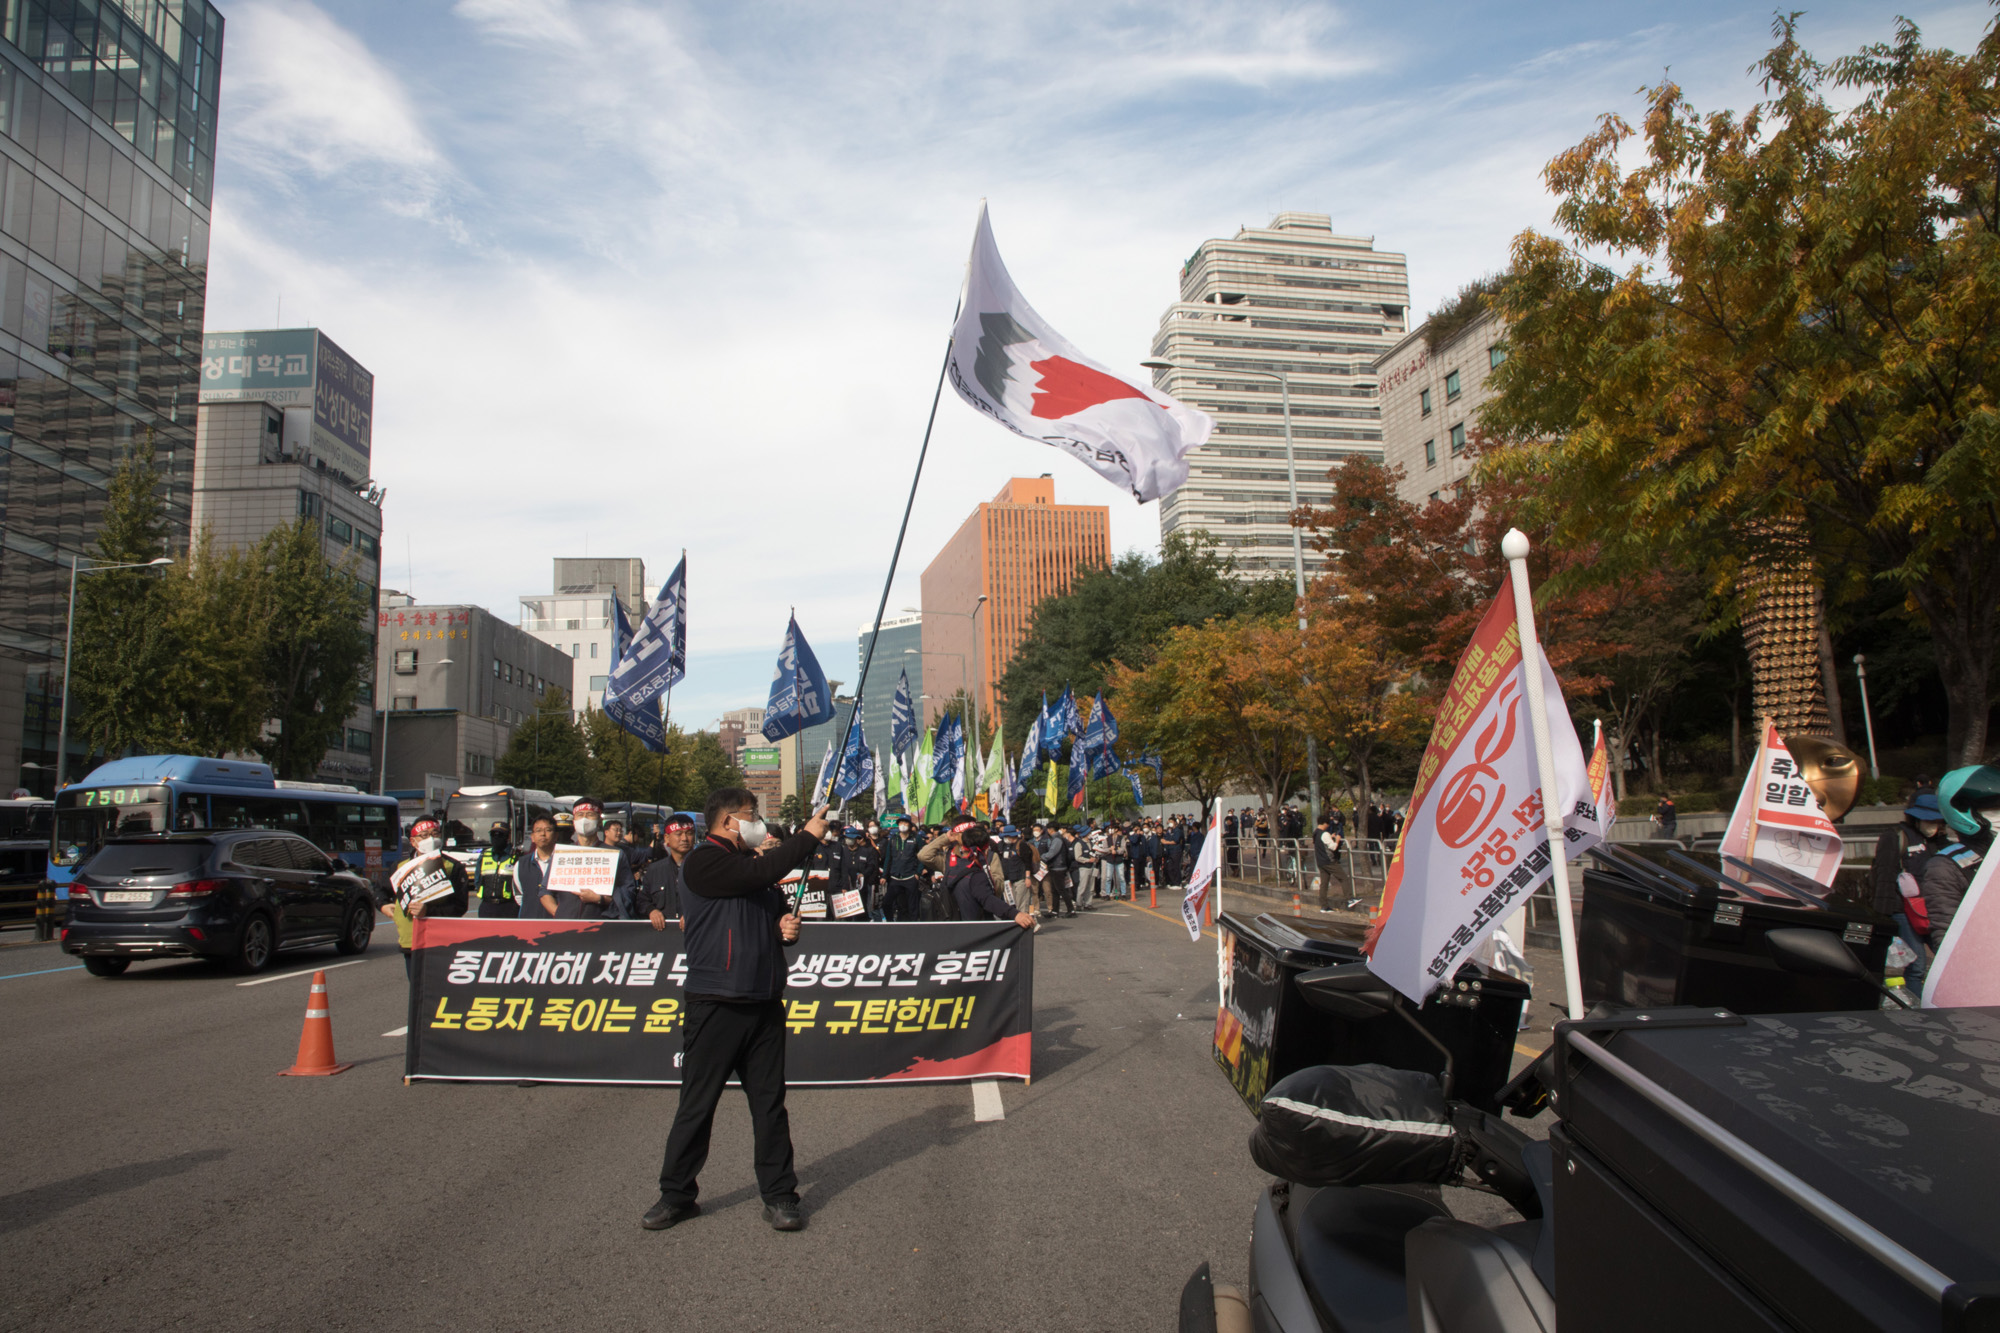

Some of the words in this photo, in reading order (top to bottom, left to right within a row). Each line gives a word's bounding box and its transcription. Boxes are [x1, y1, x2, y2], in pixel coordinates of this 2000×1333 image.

[239, 338, 258, 349] 대학
[200, 354, 309, 380] 성대학교
[199, 390, 234, 401] SUNG
[239, 390, 300, 402] UNIVERSITY
[317, 379, 371, 449] 신성대학교
[85, 788, 141, 807] 750A
[1765, 782, 1811, 807] 일할
[555, 867, 592, 876] 중대재해
[594, 867, 611, 876] 처벌
[557, 856, 583, 866] 윤석열
[585, 856, 610, 866] 정부는
[400, 866, 426, 893] 더이상
[578, 876, 615, 887] 중단하라!
[447, 950, 592, 986] 중대재해
[592, 951, 664, 987] 처벌
[786, 952, 926, 988] 생명안전
[929, 947, 1012, 986] 후퇴!
[430, 996, 534, 1032] 노동자
[539, 997, 637, 1033] 죽이는
[642, 998, 685, 1033] 윤
[781, 999, 820, 1035] 부
[825, 996, 977, 1035] 규탄한다!
